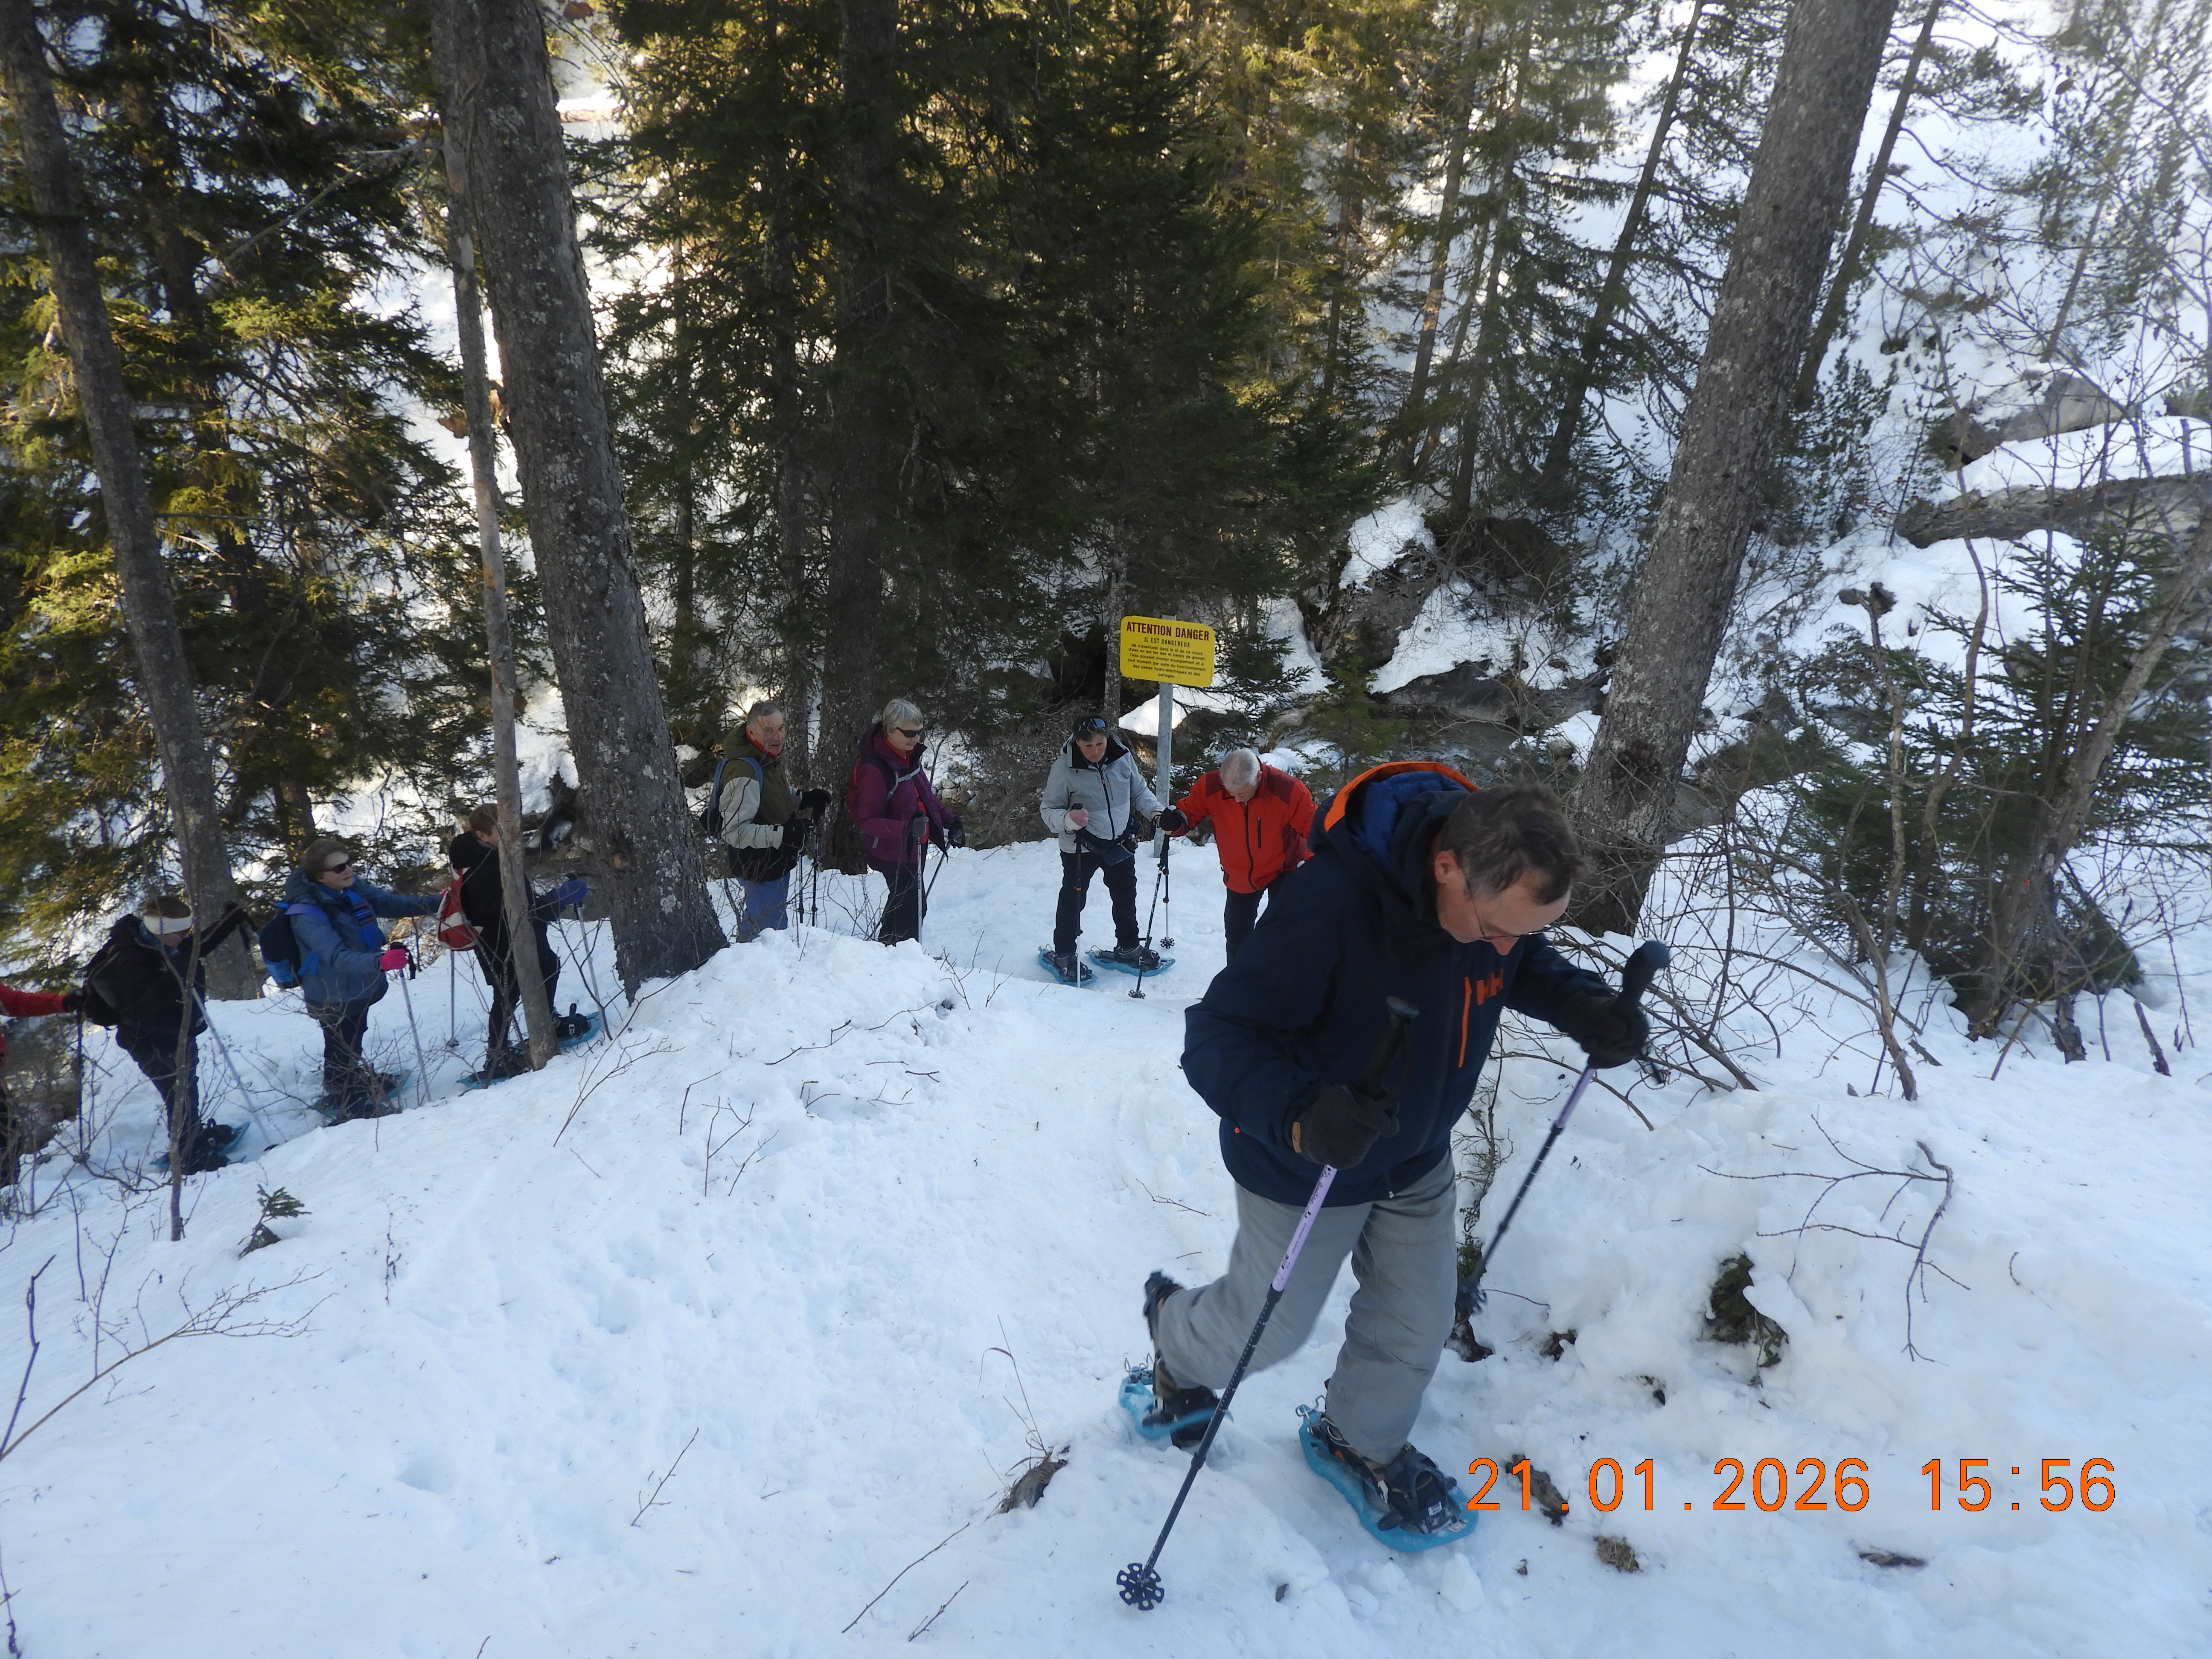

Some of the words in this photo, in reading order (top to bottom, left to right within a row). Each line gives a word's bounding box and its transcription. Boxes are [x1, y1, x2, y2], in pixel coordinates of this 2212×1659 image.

[1126, 622, 1172, 636] ATTENTION
[1176, 627, 1209, 641] DANGER
[1161, 639, 1190, 647] DANGEREUX
